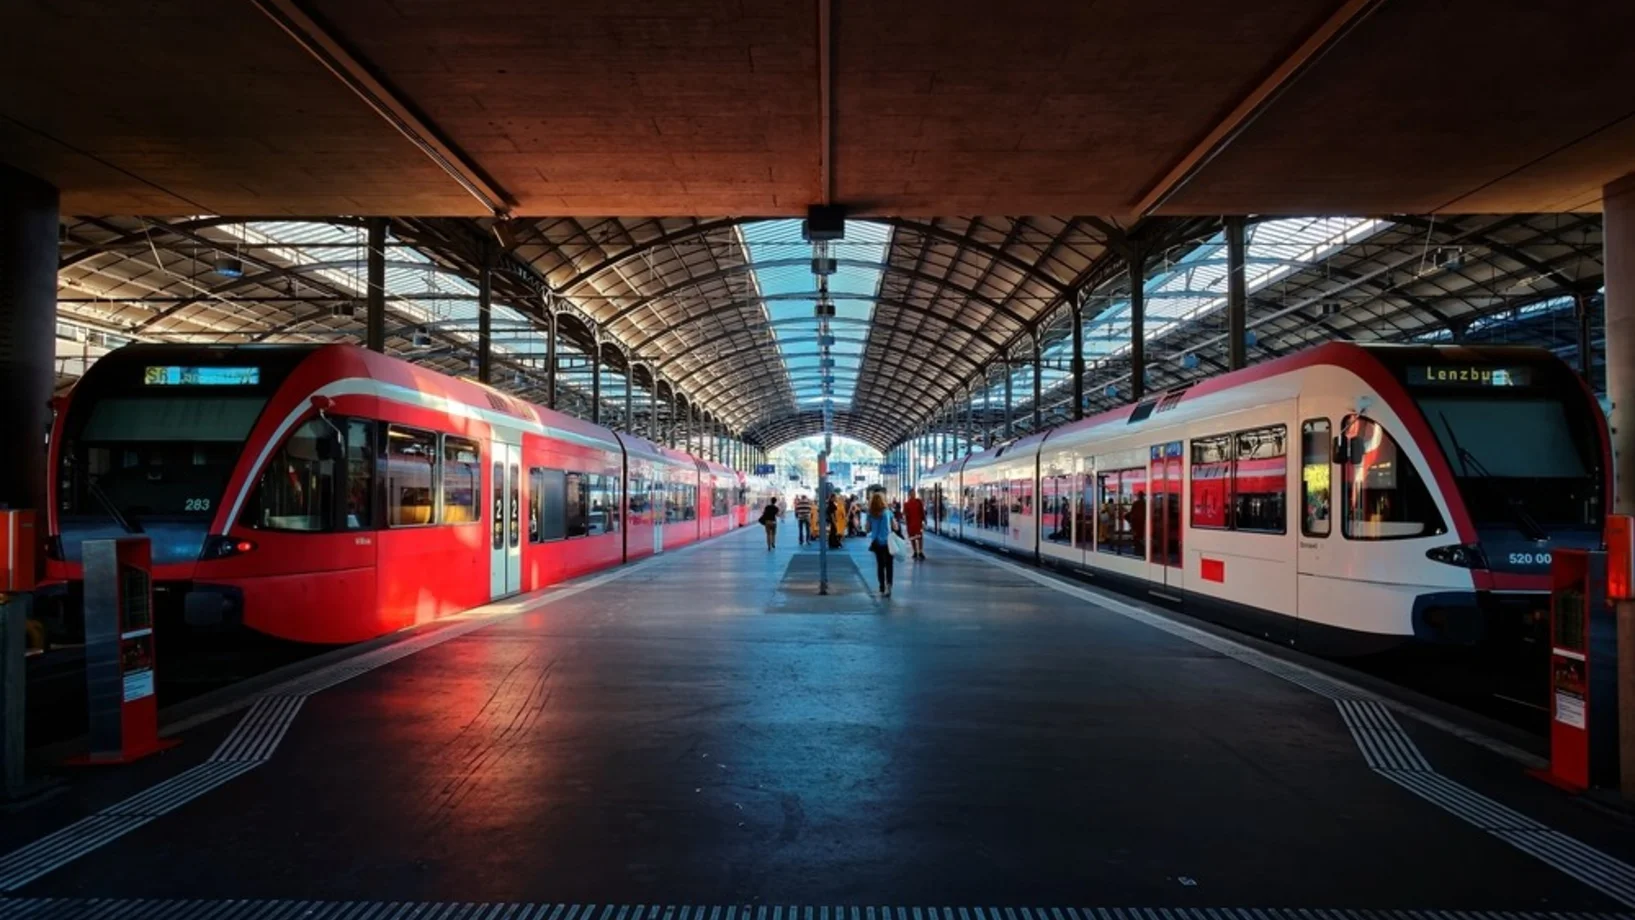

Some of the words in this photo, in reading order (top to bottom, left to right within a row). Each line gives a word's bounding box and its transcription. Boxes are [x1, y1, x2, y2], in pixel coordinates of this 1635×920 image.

[1426, 366, 1509, 383] Lenzbu
[184, 497, 211, 511] 283
[1509, 552, 1533, 565] 520
